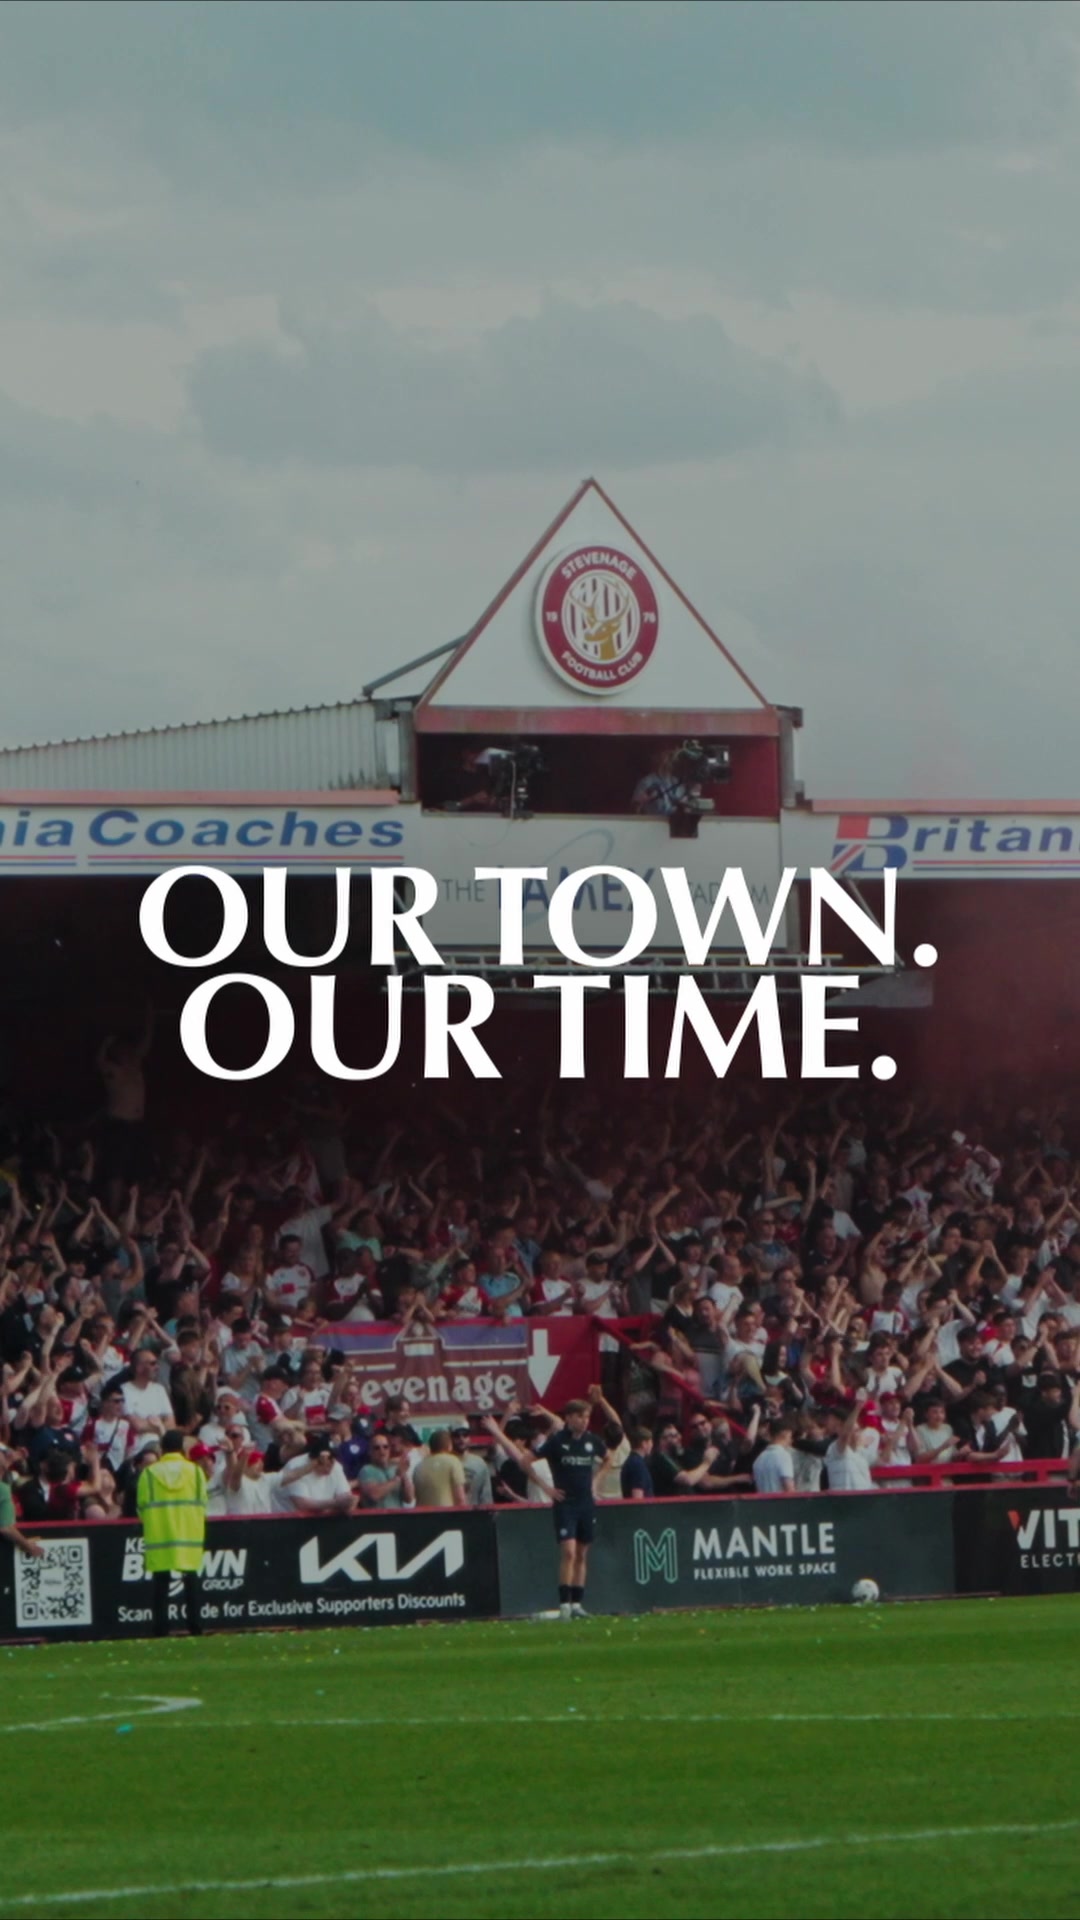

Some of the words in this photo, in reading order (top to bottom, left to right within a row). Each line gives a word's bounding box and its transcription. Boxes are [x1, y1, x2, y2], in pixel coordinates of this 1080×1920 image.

[561, 552, 637, 580] STEVENAGE
[561, 651, 616, 680] FOOTBALL
[618, 652, 643, 677] CLUB
[88, 809, 404, 847] Coaches
[828, 815, 1080, 872] Britan
[441, 879, 485, 902] THE
[361, 1371, 516, 1410] evenage
[299, 1529, 464, 1584] KIA
[692, 1522, 835, 1561] MANTLE
[122, 1549, 248, 1582] BWN
[694, 1566, 749, 1580] FLEXIBLE
[754, 1564, 793, 1577] WORK
[798, 1562, 836, 1575] SPACE
[202, 1578, 244, 1591] GROUP
[118, 1606, 153, 1622] Scan
[181, 1603, 219, 1620] Cde
[223, 1601, 245, 1617] for
[248, 1600, 314, 1616] Exclusive
[316, 1597, 394, 1615] Supporters
[397, 1593, 466, 1609] Discounts
